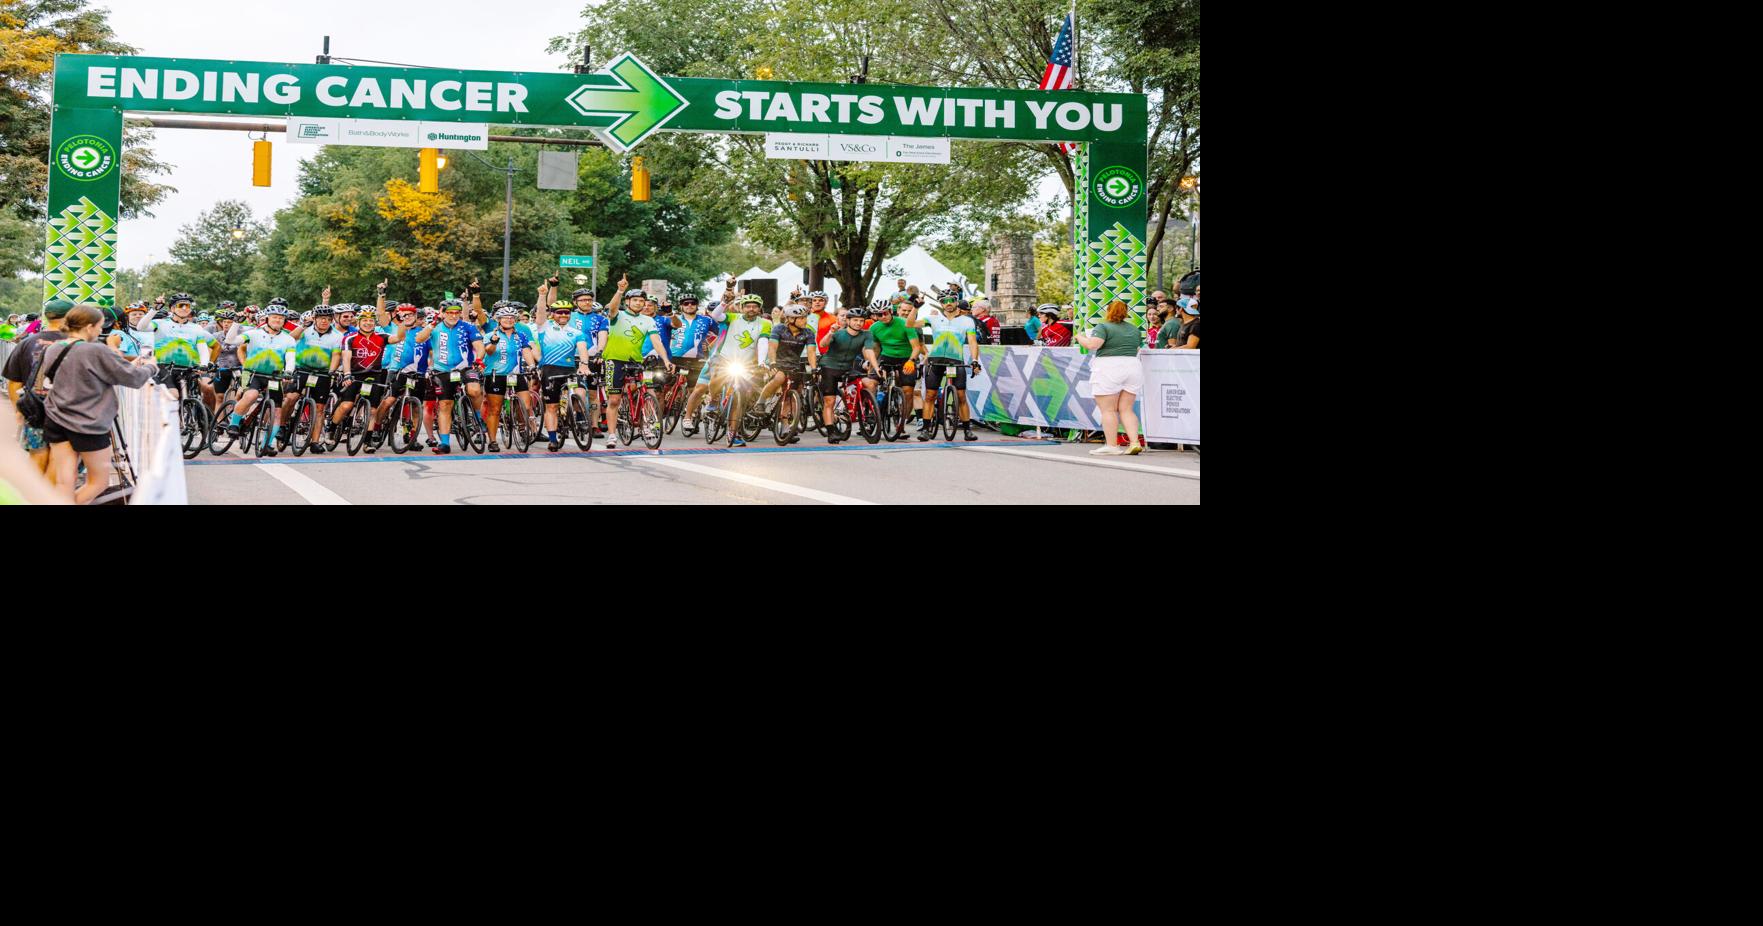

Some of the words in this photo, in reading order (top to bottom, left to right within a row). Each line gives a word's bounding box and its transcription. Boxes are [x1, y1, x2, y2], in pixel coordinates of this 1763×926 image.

[87, 66, 301, 105] ENDING
[315, 76, 530, 113] CANCER
[714, 90, 885, 125] STARTS
[893, 96, 1016, 129] WITH
[1025, 100, 1123, 132] YOU
[438, 133, 481, 142] Huntington
[840, 143, 877, 153] VS&Co
[60, 154, 84, 177] ENDING
[85, 155, 111, 177] CANCER
